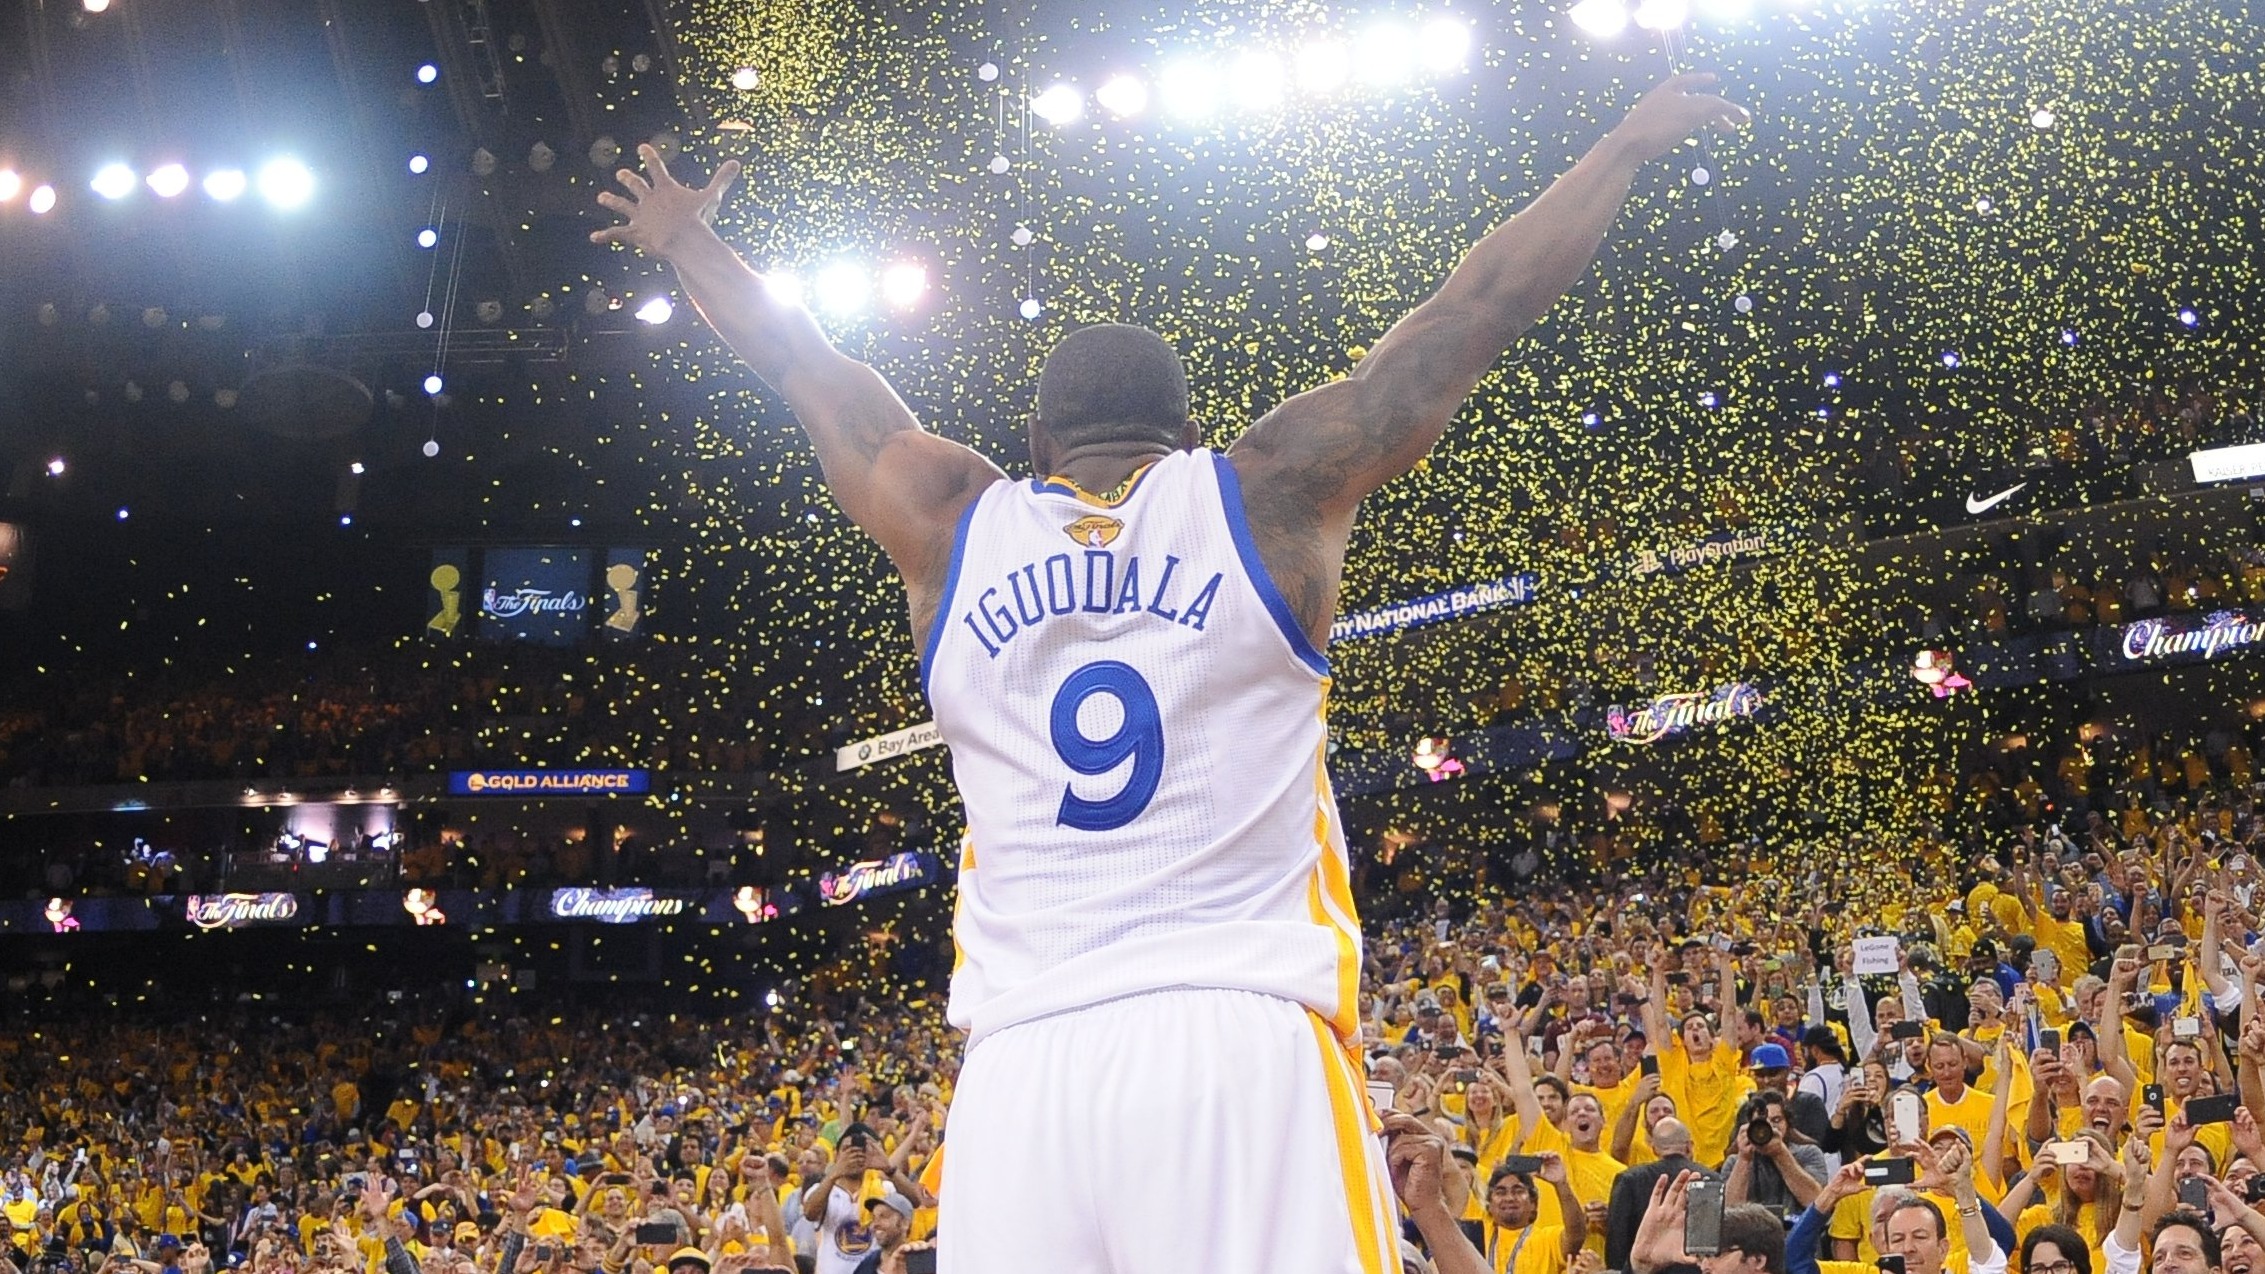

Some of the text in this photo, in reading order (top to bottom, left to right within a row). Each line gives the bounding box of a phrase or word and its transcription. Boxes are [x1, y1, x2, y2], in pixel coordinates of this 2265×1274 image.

[1670, 536, 1766, 565] PlayStation
[491, 588, 586, 618] Finals
[964, 550, 1223, 659] IGUODALA
[1329, 586, 1509, 640] ITY NATIONAL BANK
[878, 730, 940, 755] Bay Area
[1050, 660, 1165, 832] 9
[488, 774, 630, 790] GOLD ALLIANCE
[194, 892, 298, 929] Finals
[556, 889, 683, 923] Champions
[1862, 957, 1889, 965] Fishing
